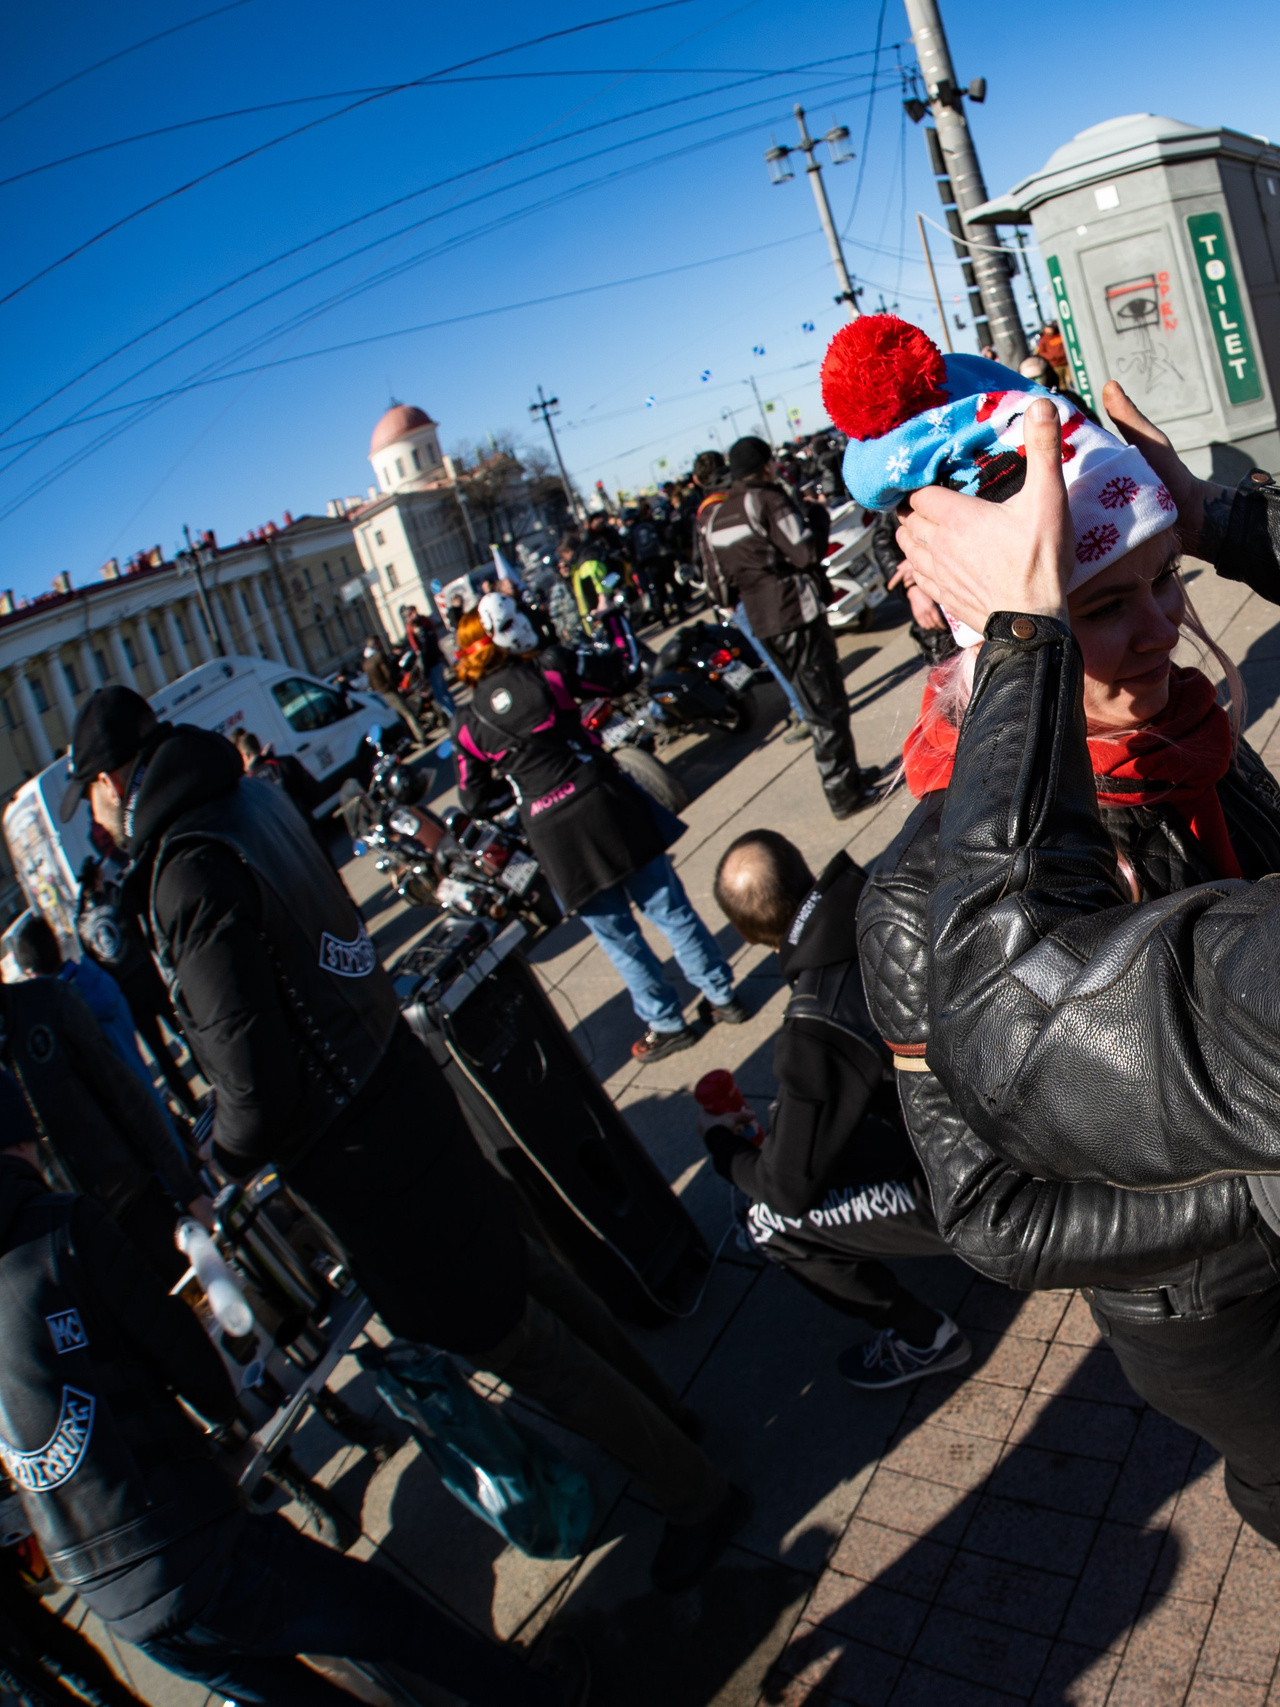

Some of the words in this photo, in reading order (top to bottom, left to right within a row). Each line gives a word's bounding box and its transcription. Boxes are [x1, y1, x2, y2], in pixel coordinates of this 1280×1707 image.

[1053, 275, 1093, 409] TOILET
[1157, 271, 1178, 331] OPEN
[1199, 234, 1248, 380] TOILET
